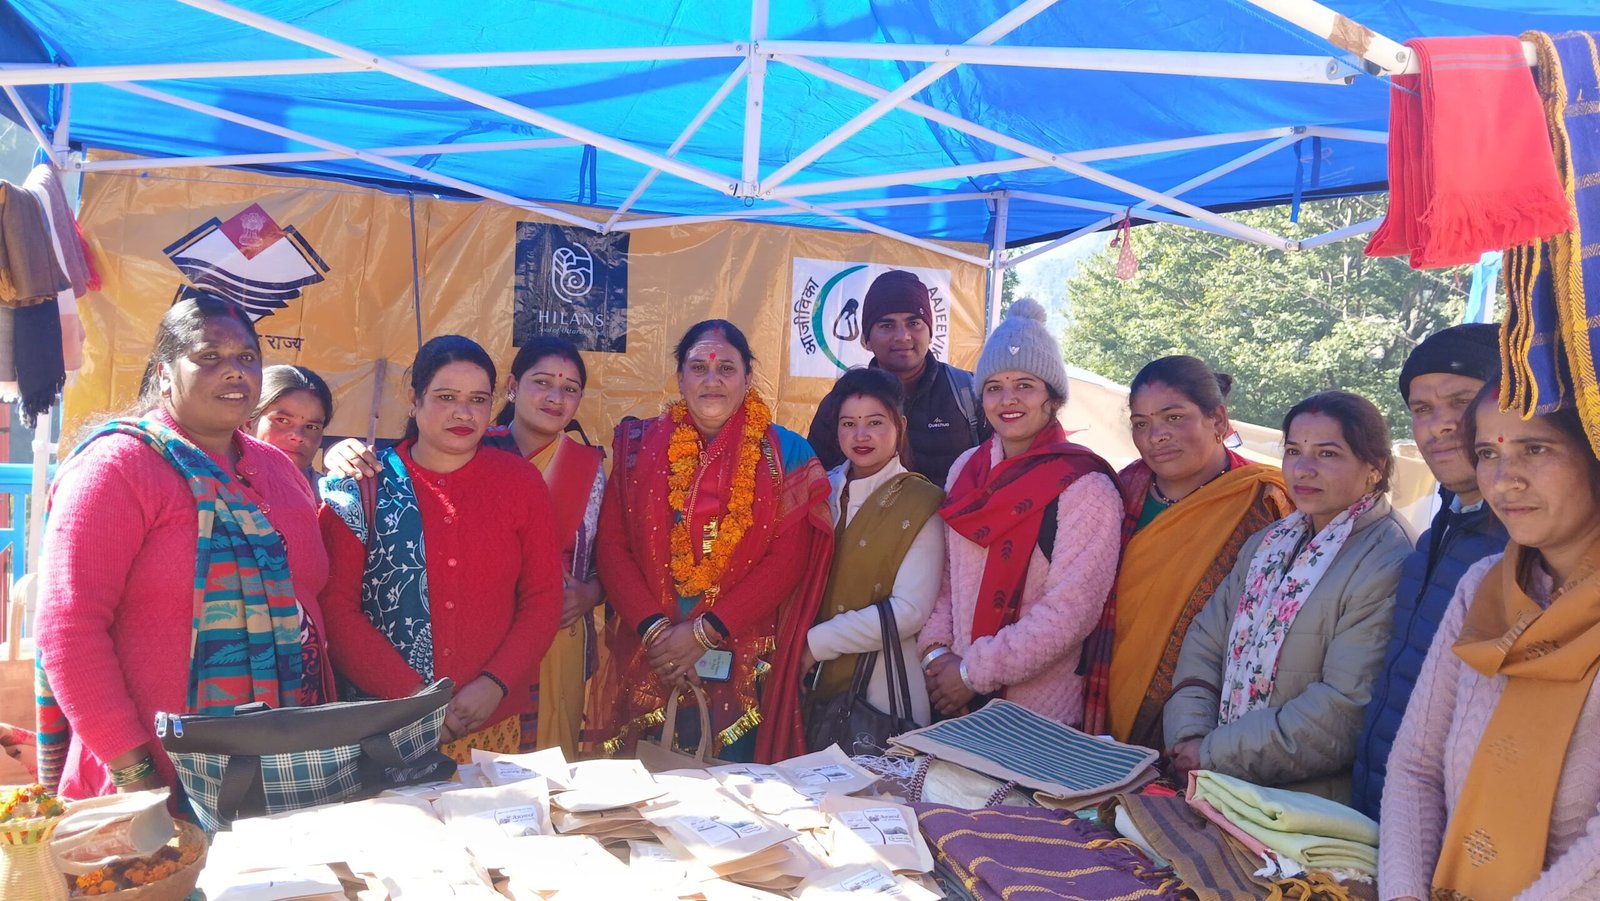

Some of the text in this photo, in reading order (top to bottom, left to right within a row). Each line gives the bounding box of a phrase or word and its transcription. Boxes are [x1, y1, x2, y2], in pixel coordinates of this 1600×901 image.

[538, 310, 604, 328] HILANS
[793, 276, 820, 356] आजीविका
[927, 286, 948, 361] AAJEEVIK
[265, 334, 304, 351] राज्य
